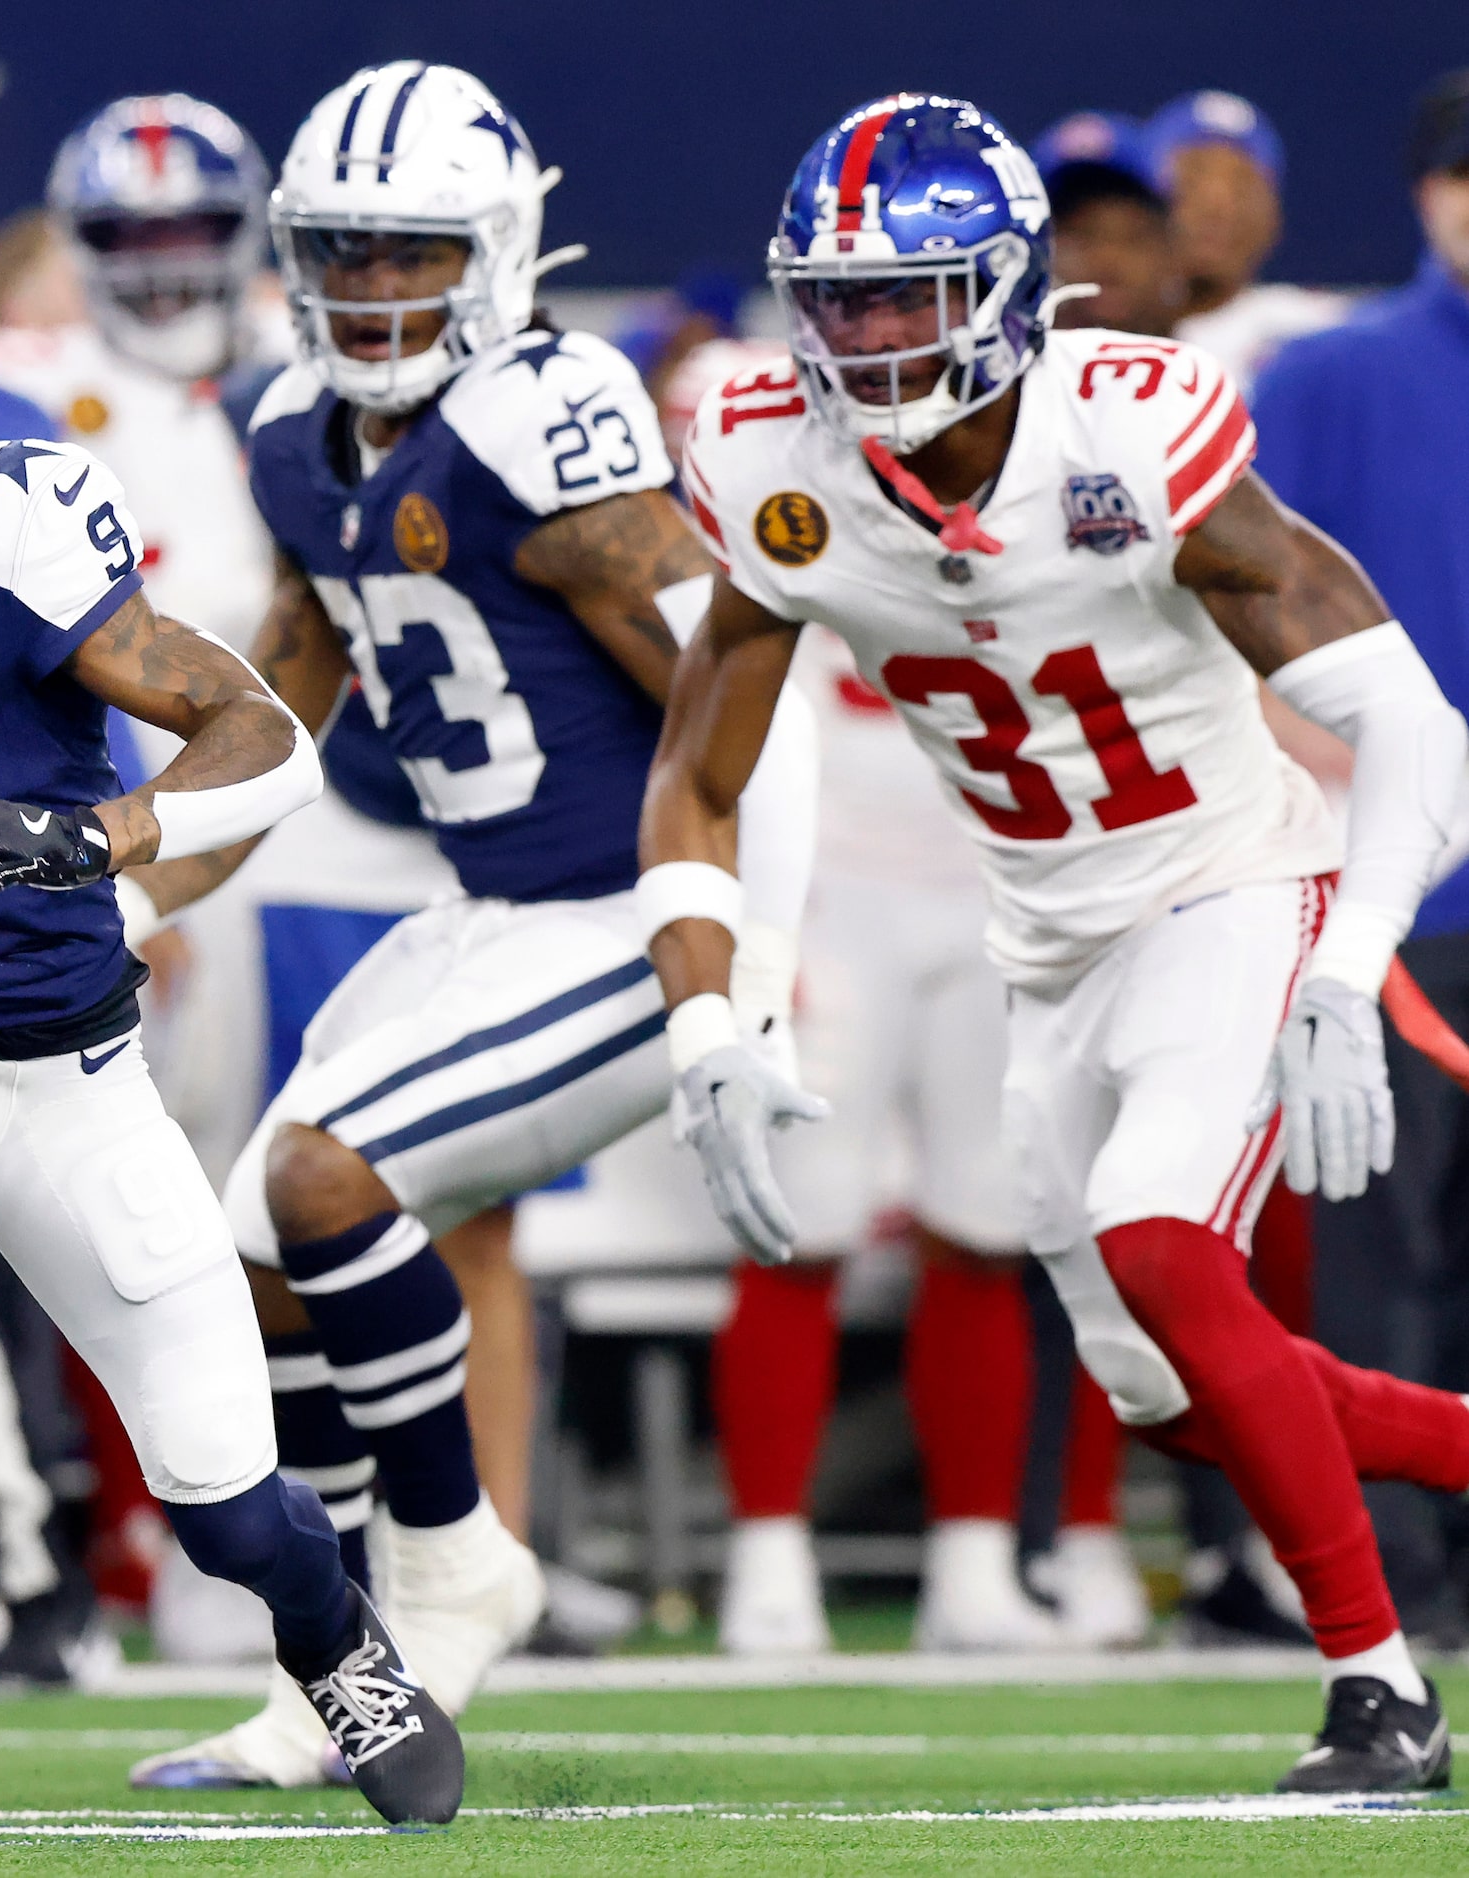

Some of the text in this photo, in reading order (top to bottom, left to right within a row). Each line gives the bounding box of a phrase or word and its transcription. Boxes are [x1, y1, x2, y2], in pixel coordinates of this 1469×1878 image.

[813, 184, 883, 232] 31
[721, 372, 806, 435] 31
[545, 410, 639, 490] 23
[87, 500, 135, 582] 9
[881, 641, 1199, 840] 31
